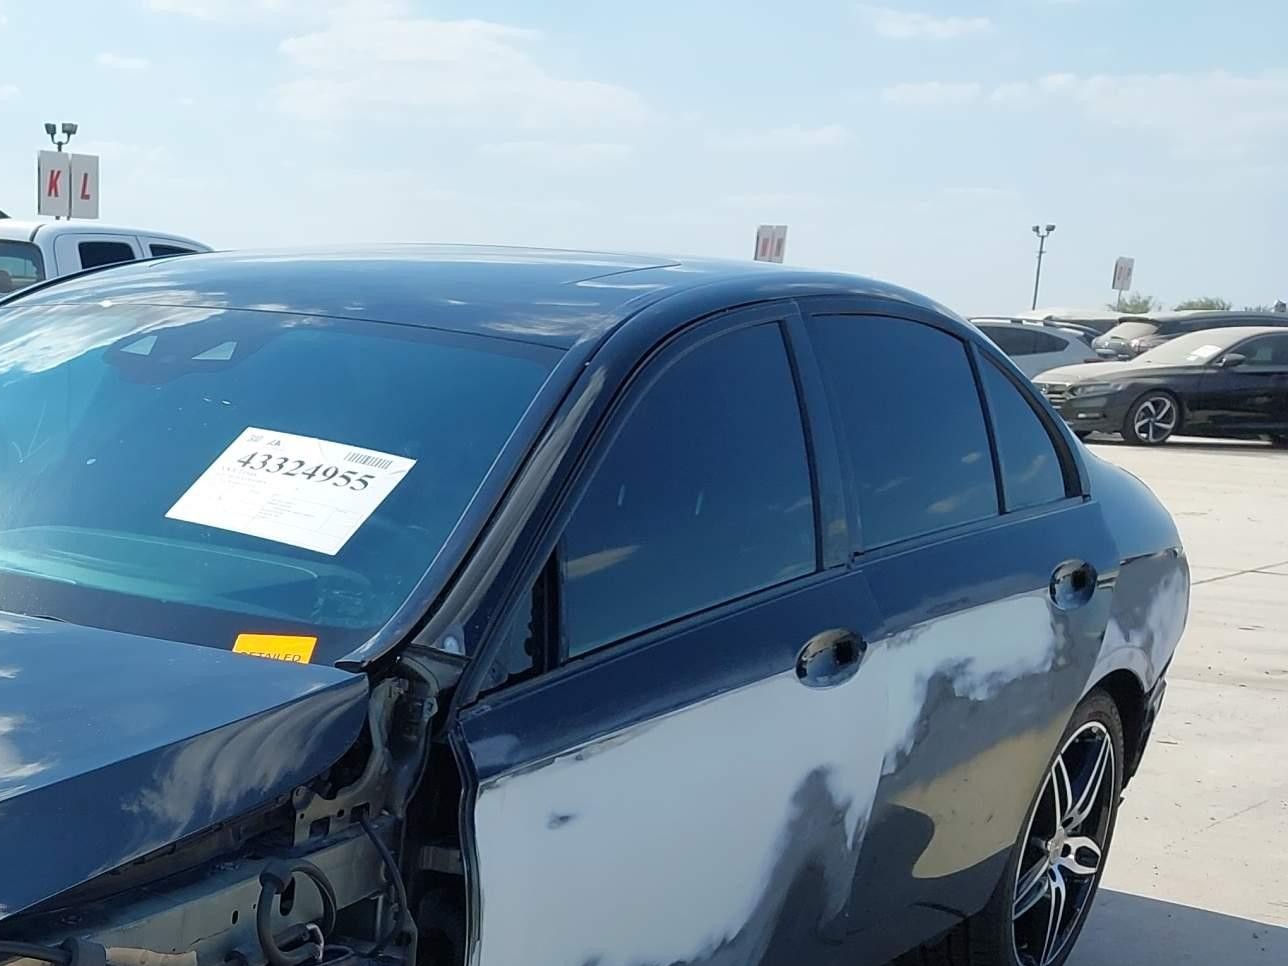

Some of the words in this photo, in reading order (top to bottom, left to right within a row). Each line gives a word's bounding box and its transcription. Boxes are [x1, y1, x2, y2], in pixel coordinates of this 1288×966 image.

[47, 169, 62, 198] K
[80, 172, 91, 201] L
[236, 450, 376, 492] 43324955
